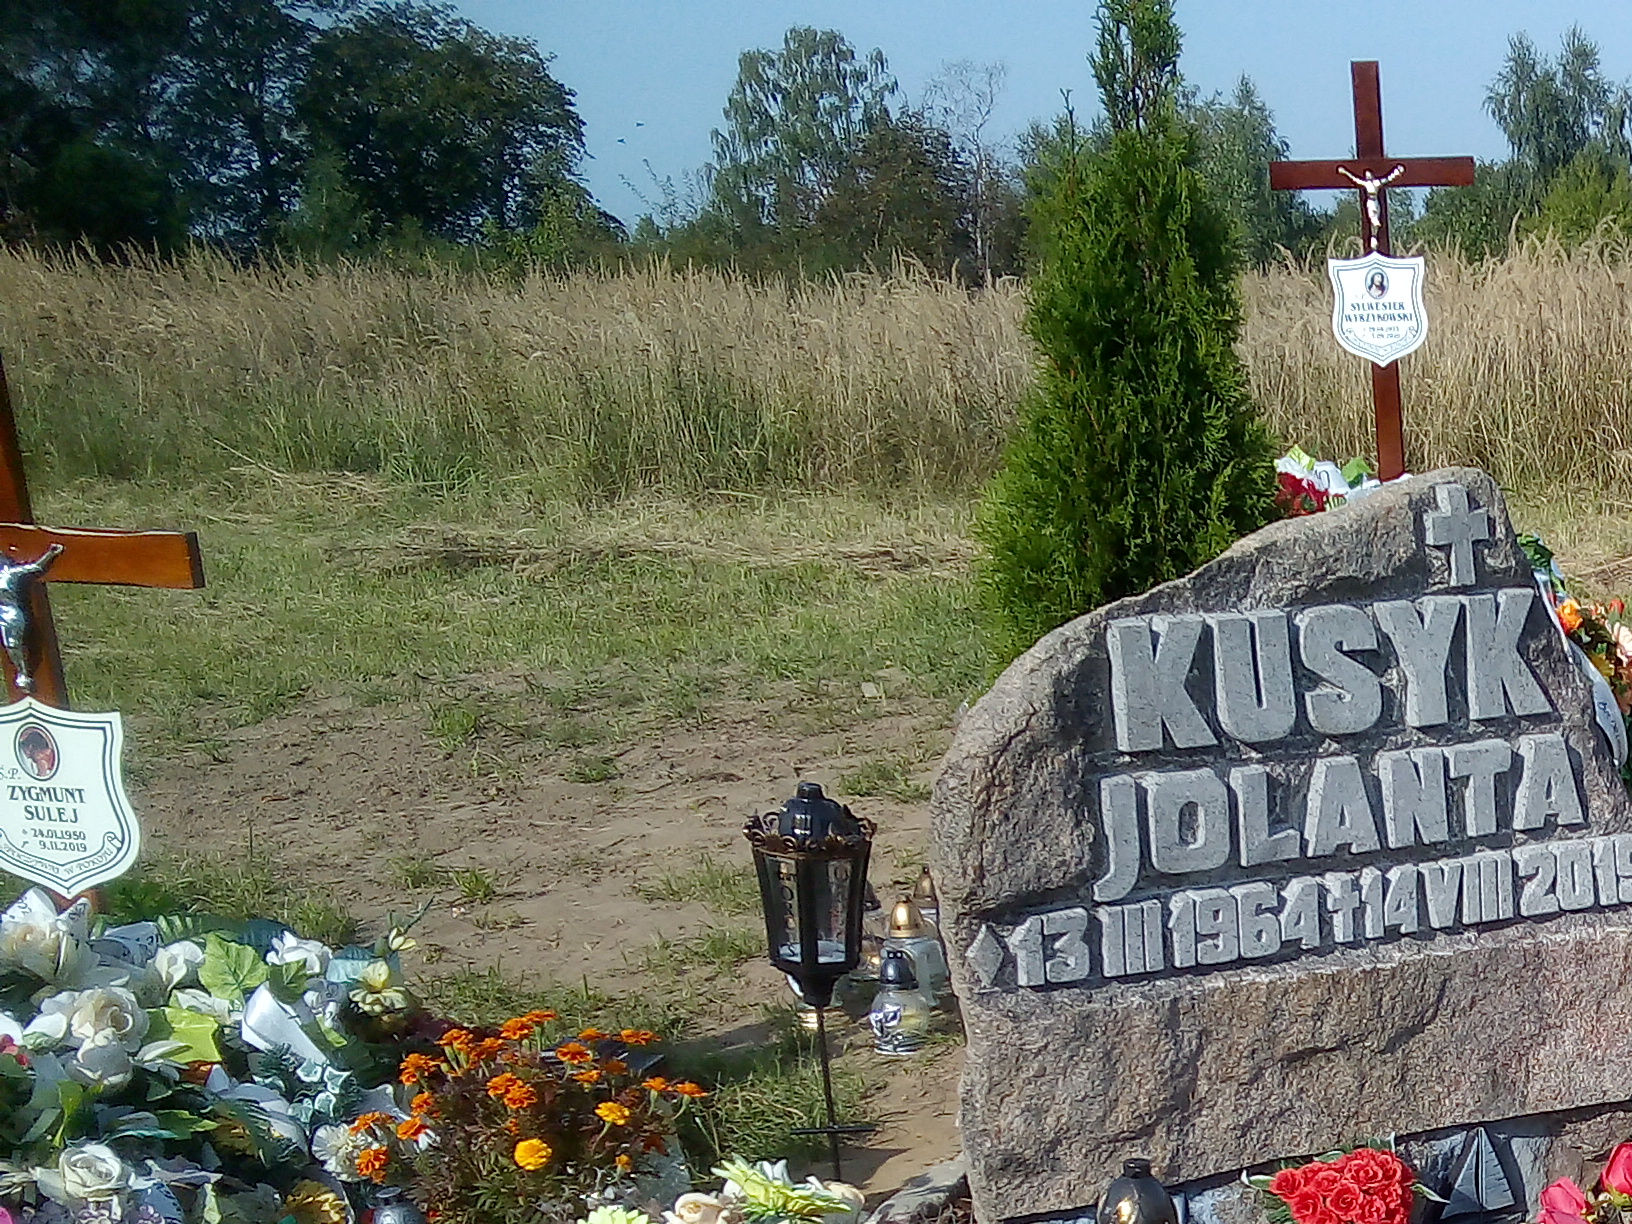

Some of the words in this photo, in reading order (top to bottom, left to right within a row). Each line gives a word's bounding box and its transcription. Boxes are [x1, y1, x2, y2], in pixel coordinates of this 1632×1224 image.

[1106, 587, 1551, 752] KUSYK
[7, 785, 86, 804] ZYGMUNT
[24, 805, 79, 824] SULEJ
[1094, 734, 1586, 901] JOLANTA
[1007, 907, 1090, 987] 13
[1097, 899, 1164, 978] III
[1168, 877, 1320, 968] 1964
[1418, 850, 1514, 930] VIII
